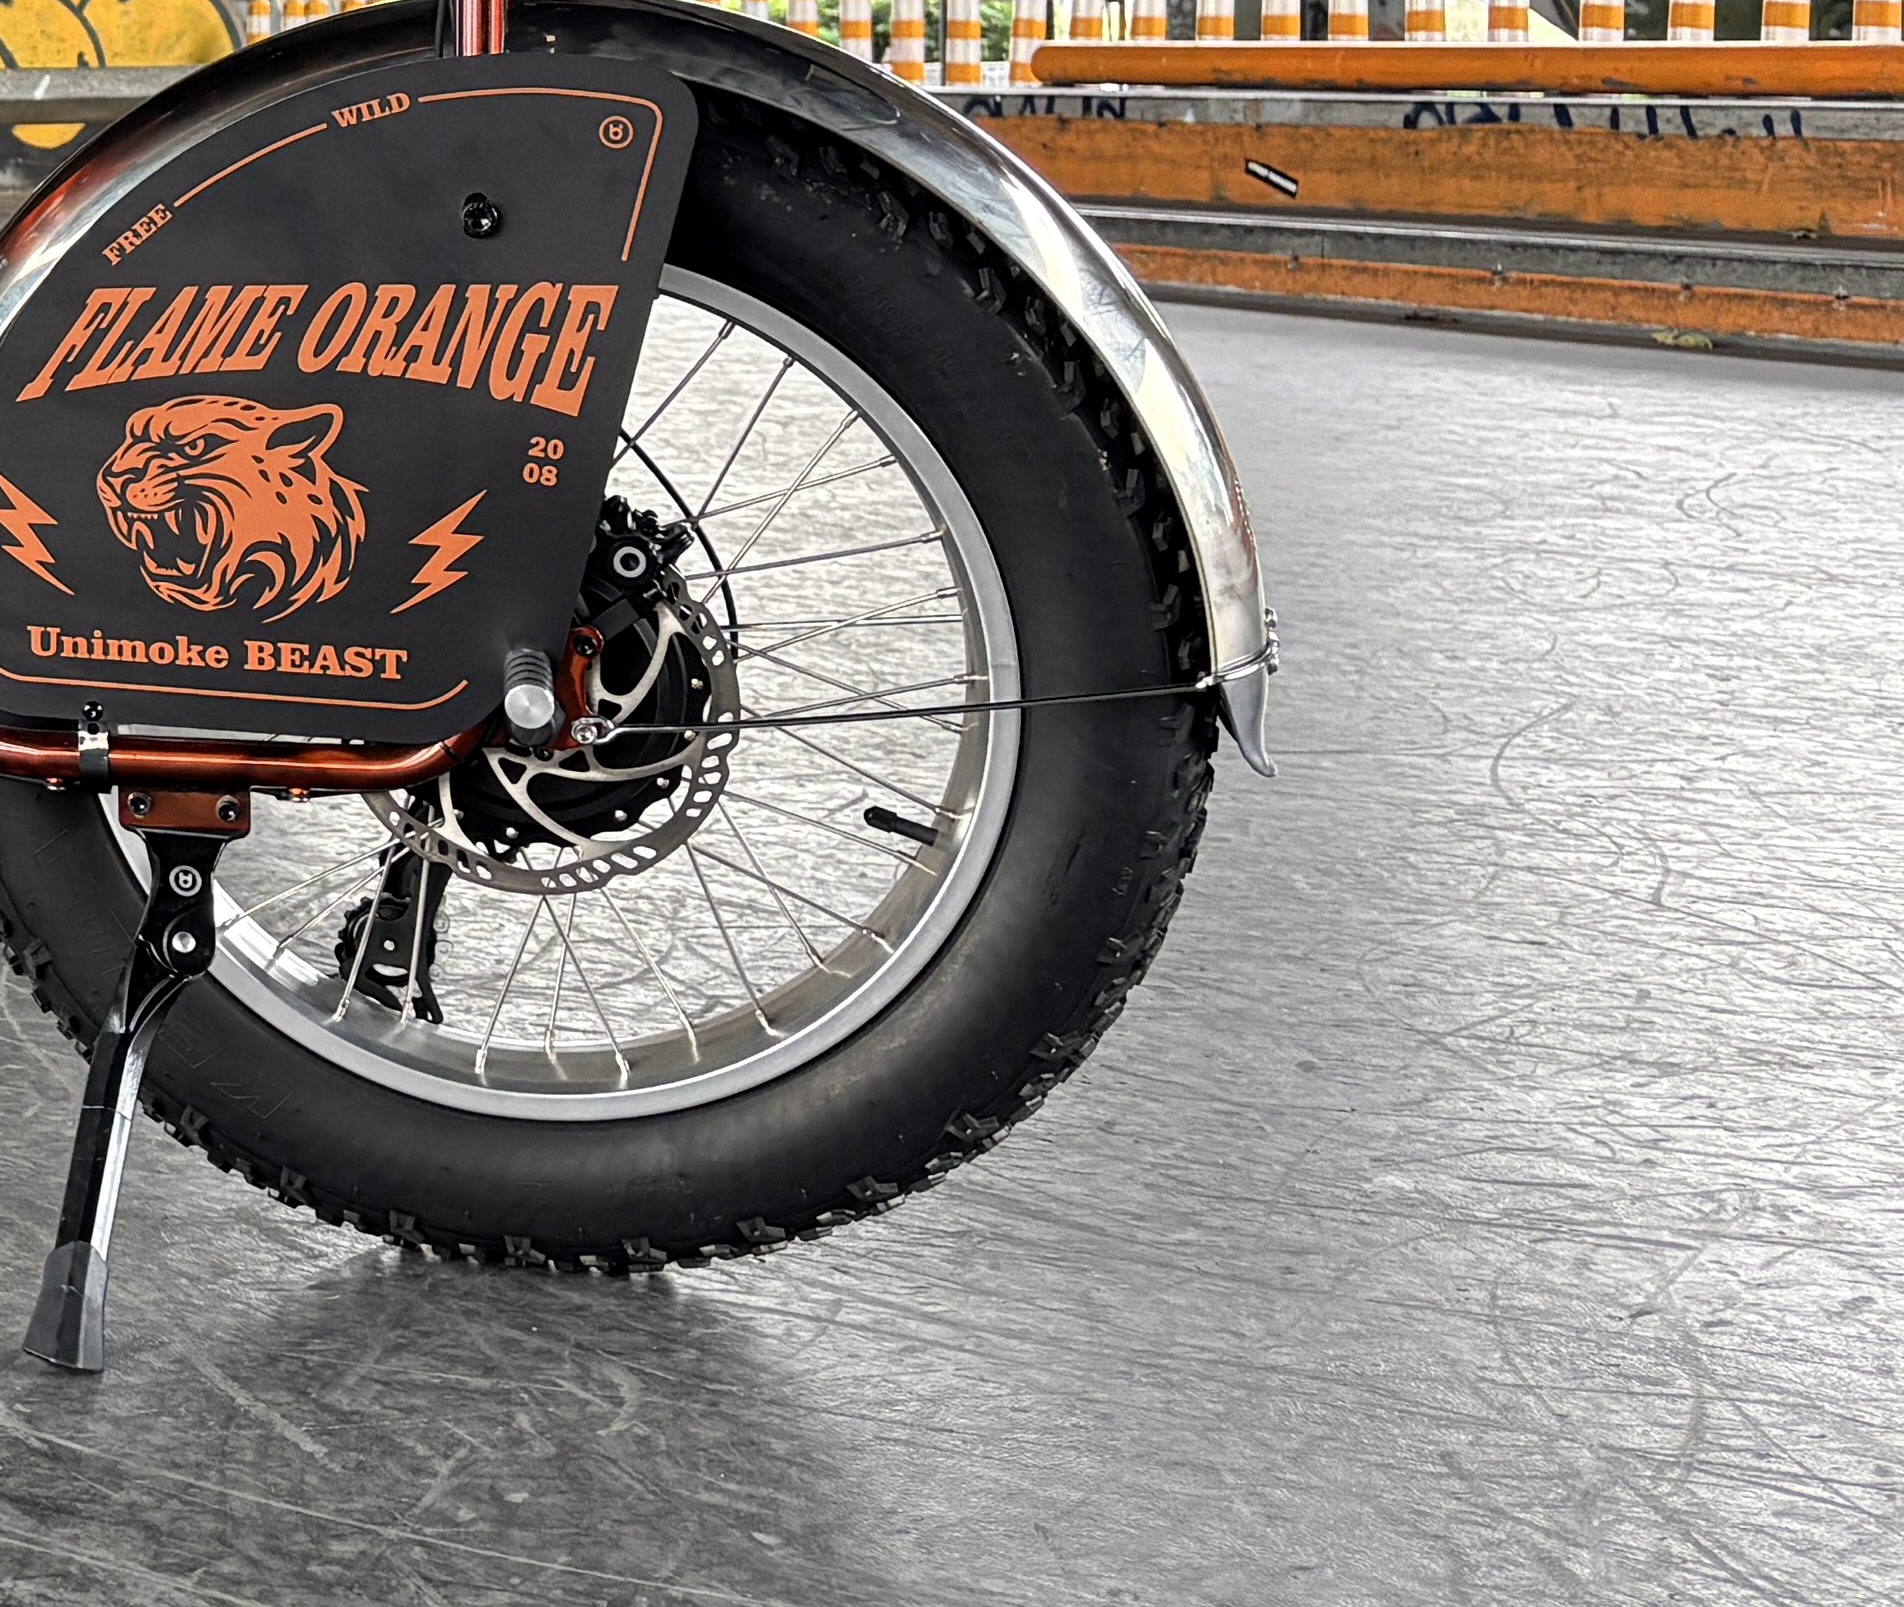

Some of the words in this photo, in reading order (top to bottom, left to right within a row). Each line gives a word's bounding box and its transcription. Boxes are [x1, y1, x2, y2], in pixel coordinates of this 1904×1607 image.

[102, 203, 172, 266] FREE
[331, 92, 411, 130] WILD
[16, 284, 309, 402] FLAME
[297, 281, 619, 418] ORANGE
[522, 462, 558, 487] 08
[529, 437, 565, 461] 20
[26, 625, 230, 670] Unimoke
[242, 639, 408, 680] BEAST
